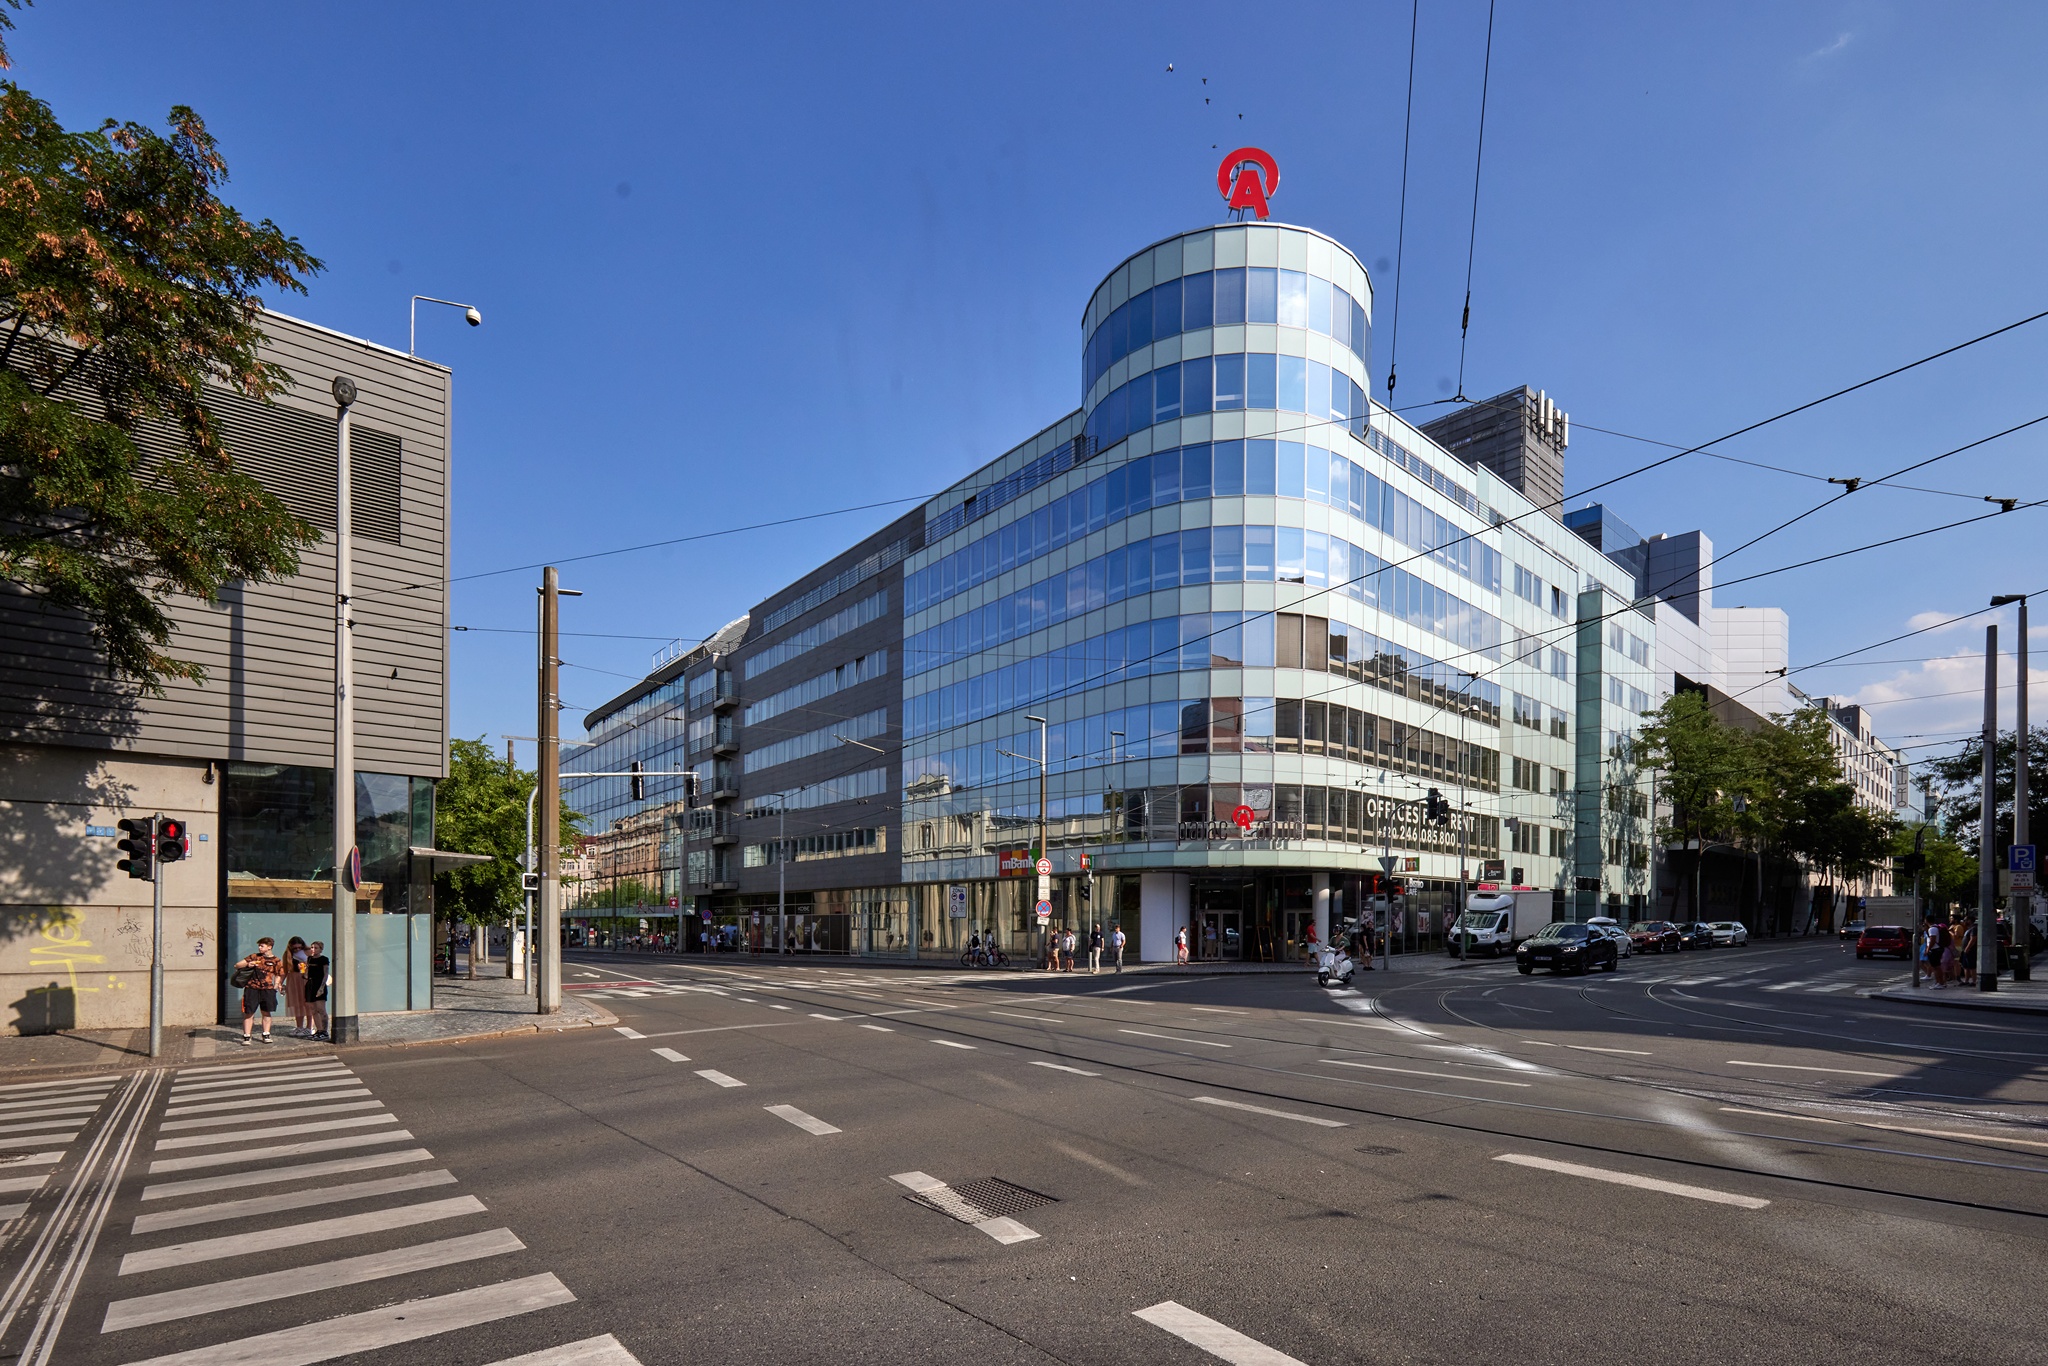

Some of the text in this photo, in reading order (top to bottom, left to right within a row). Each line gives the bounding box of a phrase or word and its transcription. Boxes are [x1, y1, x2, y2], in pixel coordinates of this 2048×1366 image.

[1367, 798, 1419, 825] OFFICES
[1450, 813, 1475, 833] RENT
[1002, 855, 1036, 870] mBank
[1082, 857, 1091, 866] m
[2014, 848, 2030, 863] P
[1407, 860, 1417, 868] m
